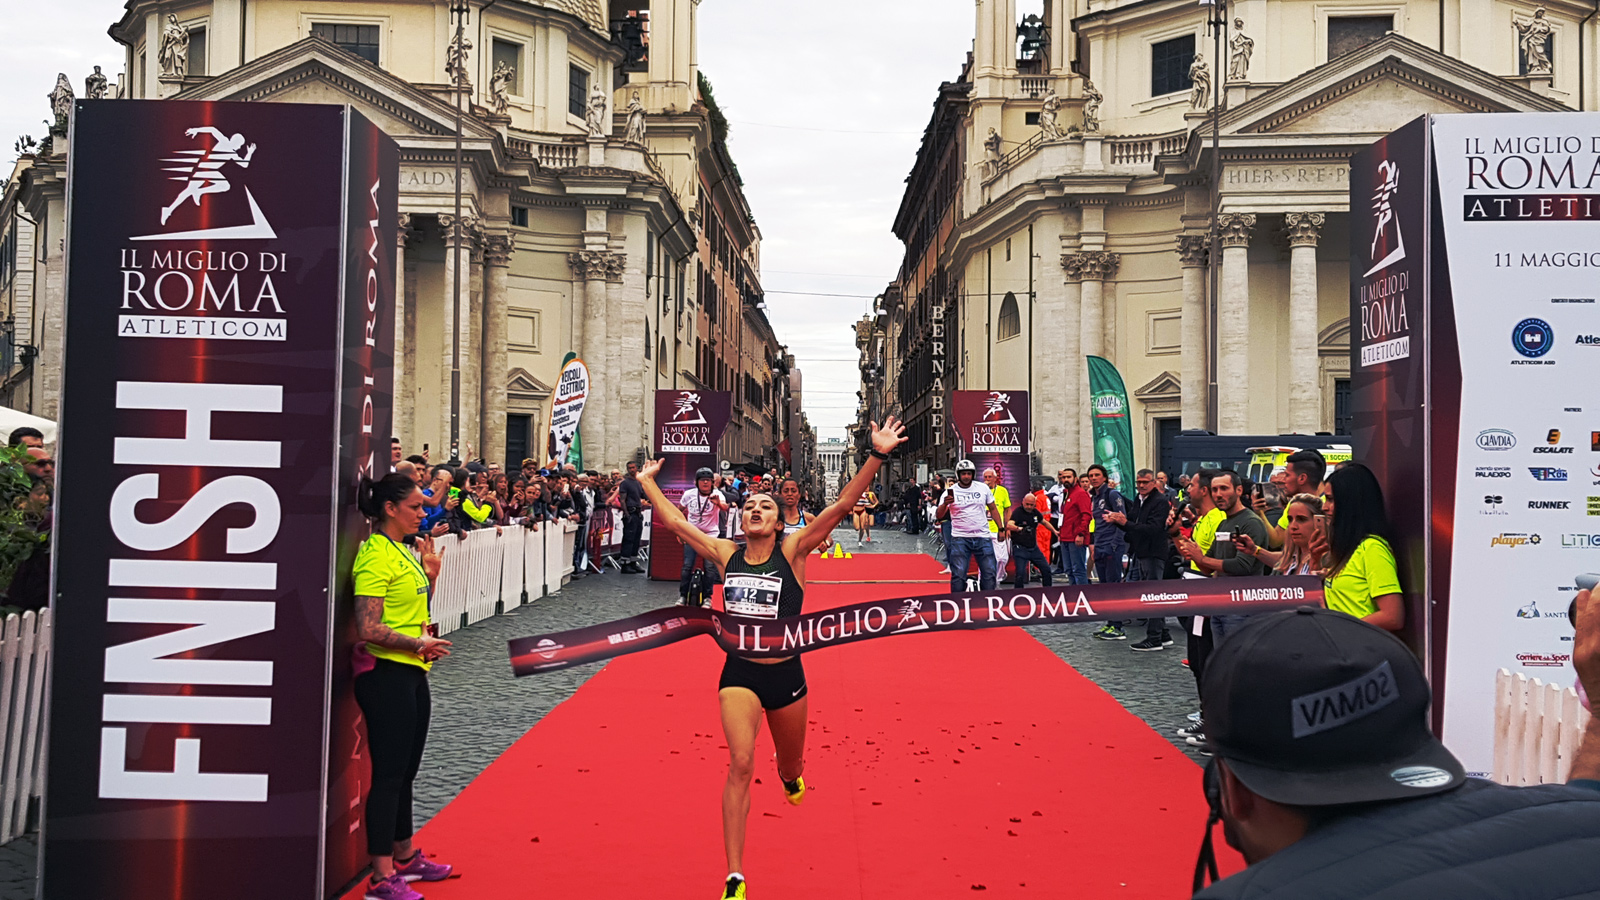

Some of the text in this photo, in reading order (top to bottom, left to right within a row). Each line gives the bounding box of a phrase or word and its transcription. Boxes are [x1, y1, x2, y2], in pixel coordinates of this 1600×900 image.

[1464, 137, 1486, 154] IL
[1493, 136, 1582, 154] MIGLIO
[120, 249, 287, 272] IL MIGLIO DI
[365, 178, 380, 347] ROMA
[1494, 252, 1600, 268] 11 MAGGIO
[120, 270, 287, 313] ROMA
[1361, 270, 1409, 304] IL MIGLIO DI
[121, 318, 283, 338] ATLETICOM
[1361, 293, 1409, 341] ROMA
[1363, 340, 1408, 364] ATLETICOM
[931, 305, 945, 446] BERNABEI
[362, 376, 374, 434] DI
[662, 433, 710, 445] ROMA
[972, 433, 1020, 445] ROMA
[99, 381, 283, 802] FINISH
[743, 588, 758, 599] 12
[1140, 592, 1188, 602] Atleticom
[1229, 587, 1304, 601] 11 MAGGIO 2019
[737, 590, 1098, 652] IL MIGLIO DI ROMA
